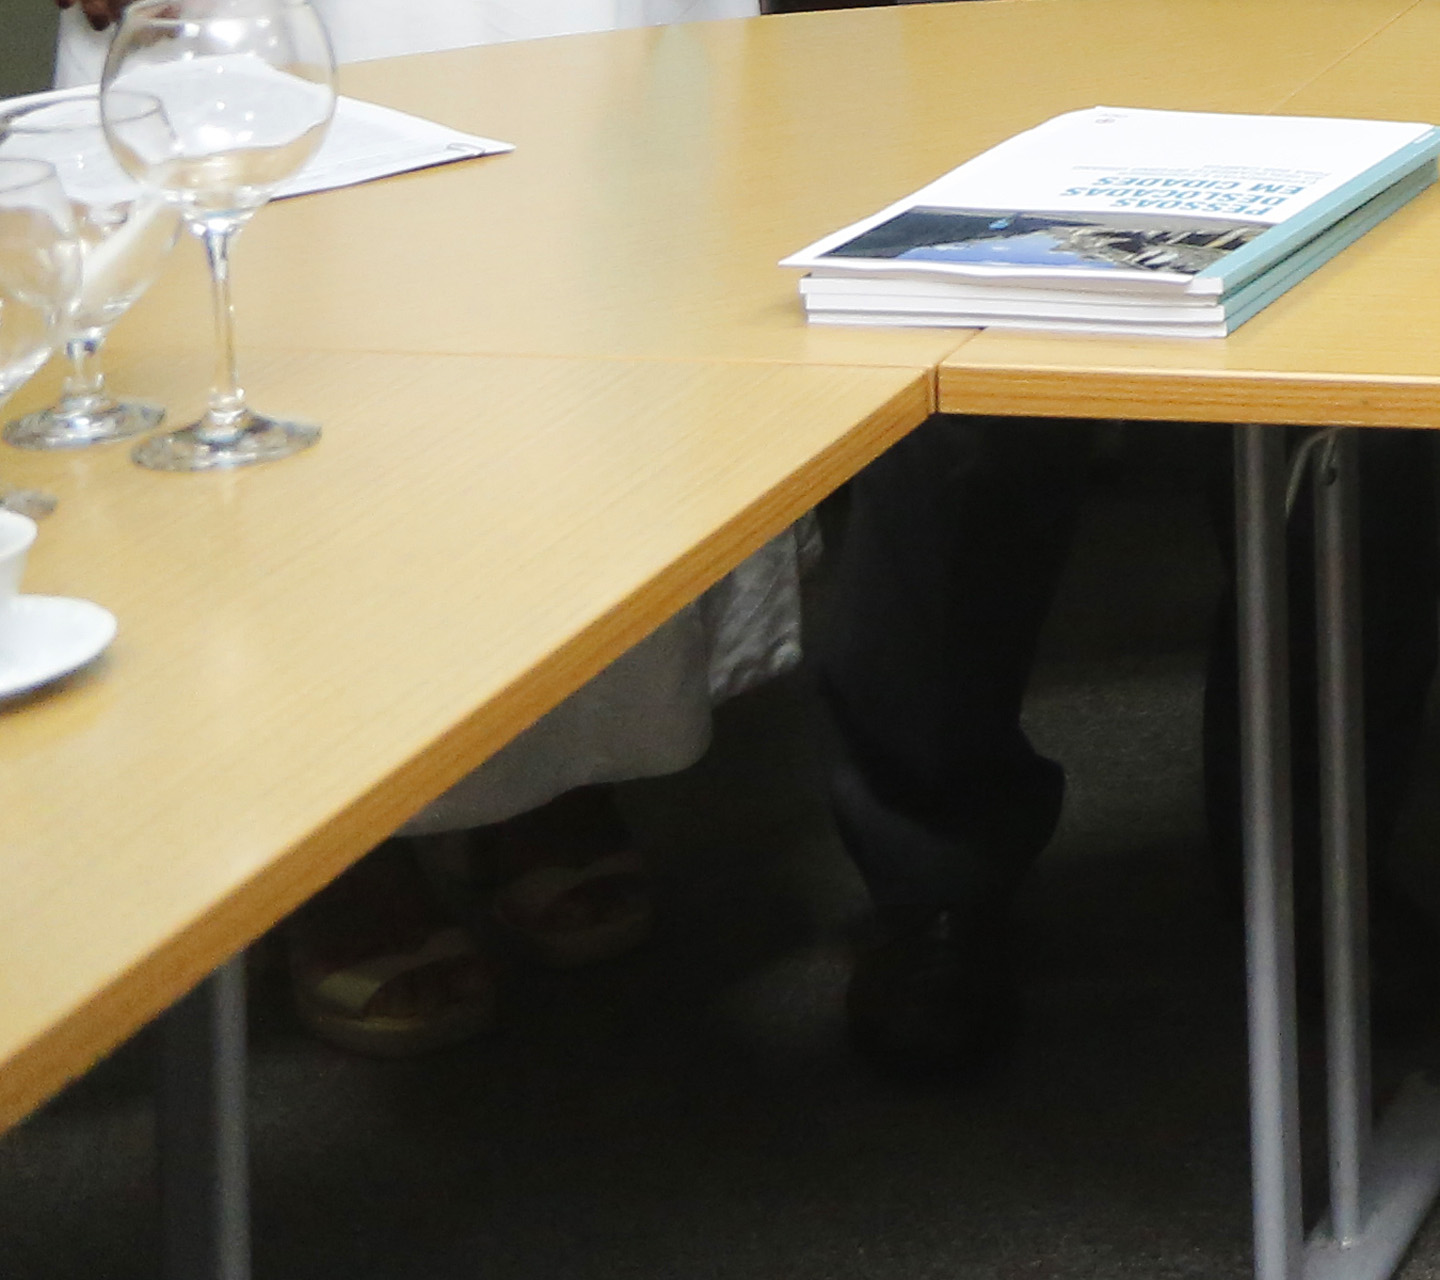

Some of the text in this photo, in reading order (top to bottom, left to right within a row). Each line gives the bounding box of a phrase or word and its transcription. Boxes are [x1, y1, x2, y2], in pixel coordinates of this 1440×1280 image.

[1092, 176, 1307, 195] EM CIDADES
[1060, 187, 1288, 206] DESLOCADAS
[1109, 198, 1274, 216] PESSOAS
